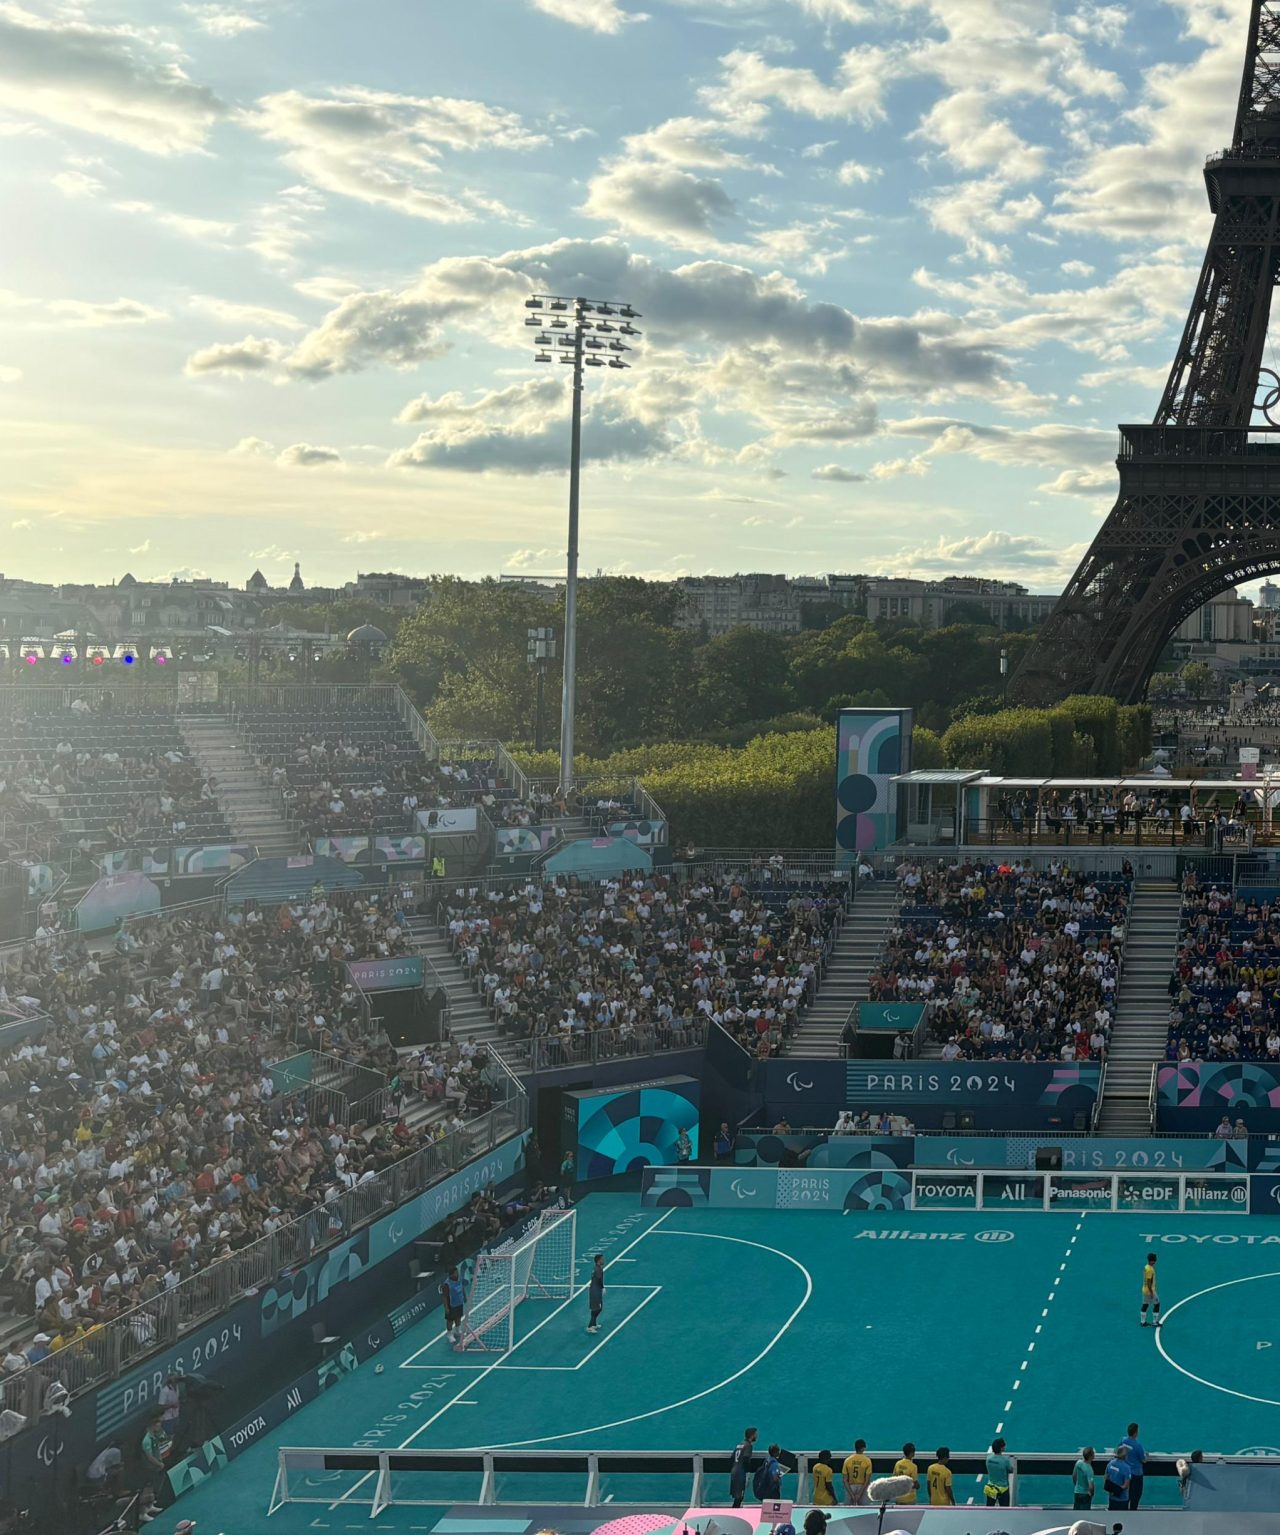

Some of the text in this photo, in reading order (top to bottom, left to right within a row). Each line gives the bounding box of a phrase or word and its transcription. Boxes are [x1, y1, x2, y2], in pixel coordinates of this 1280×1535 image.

[950, 1075, 1015, 1091] 2024
[1115, 1151, 1183, 1168] 2024
[792, 1190, 829, 1201] 2024
[917, 1185, 975, 1197] TOYOTA
[1050, 1187, 1111, 1199] Panasonic
[1185, 1187, 1228, 1200] Allianz
[854, 1230, 967, 1241] Allianz
[192, 1323, 242, 1371] 2024
[229, 1416, 266, 1448] TOYOTA
